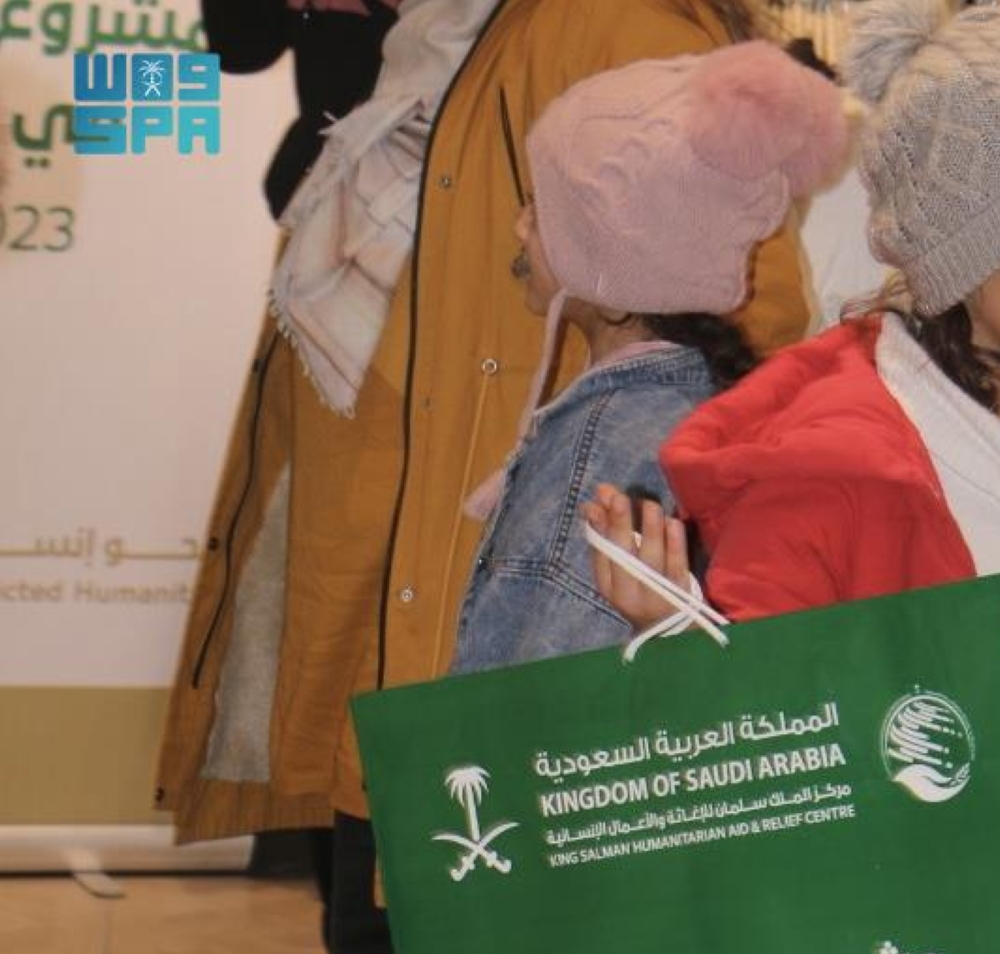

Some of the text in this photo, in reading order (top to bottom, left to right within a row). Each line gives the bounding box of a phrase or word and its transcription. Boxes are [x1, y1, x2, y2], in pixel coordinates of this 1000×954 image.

[0, 204, 75, 252] 23
[535, 702, 839, 784] المملكة العربية السعودية
[541, 743, 846, 817] KINGDOM OF SAUDI ARABIA
[769, 786, 811, 807] الملك
[814, 783, 852, 803] مركز
[715, 797, 767, 817] سلمان
[549, 804, 856, 868] KING SALMAN HUMANITARIAN AID & RELIEF CENTRE
